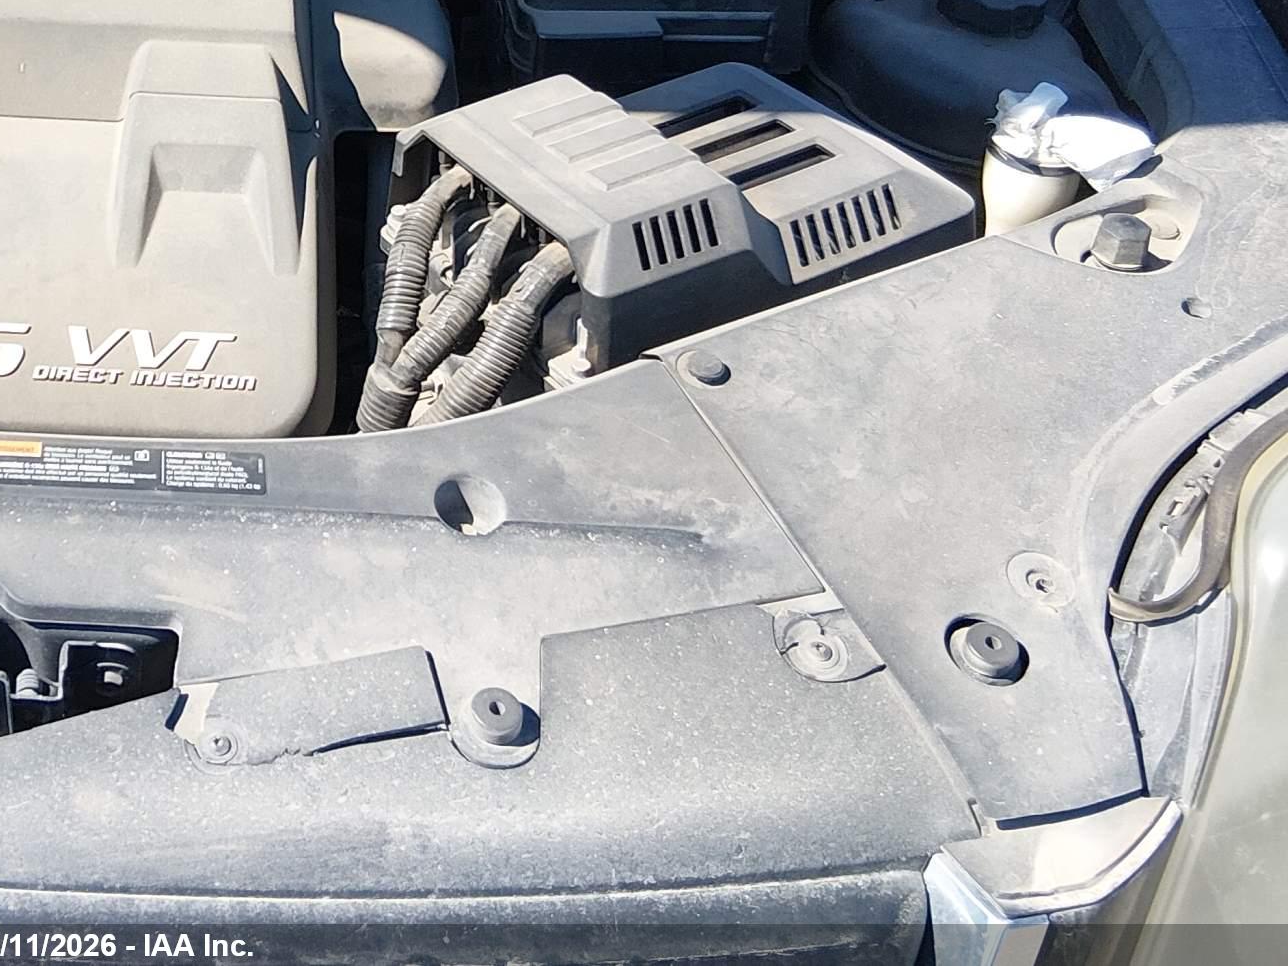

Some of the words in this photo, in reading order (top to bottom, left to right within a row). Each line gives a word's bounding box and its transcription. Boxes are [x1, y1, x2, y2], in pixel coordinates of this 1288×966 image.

[68, 325, 238, 371] VVT
[32, 365, 123, 384] DIRECT
[129, 369, 257, 391] INJECTION
